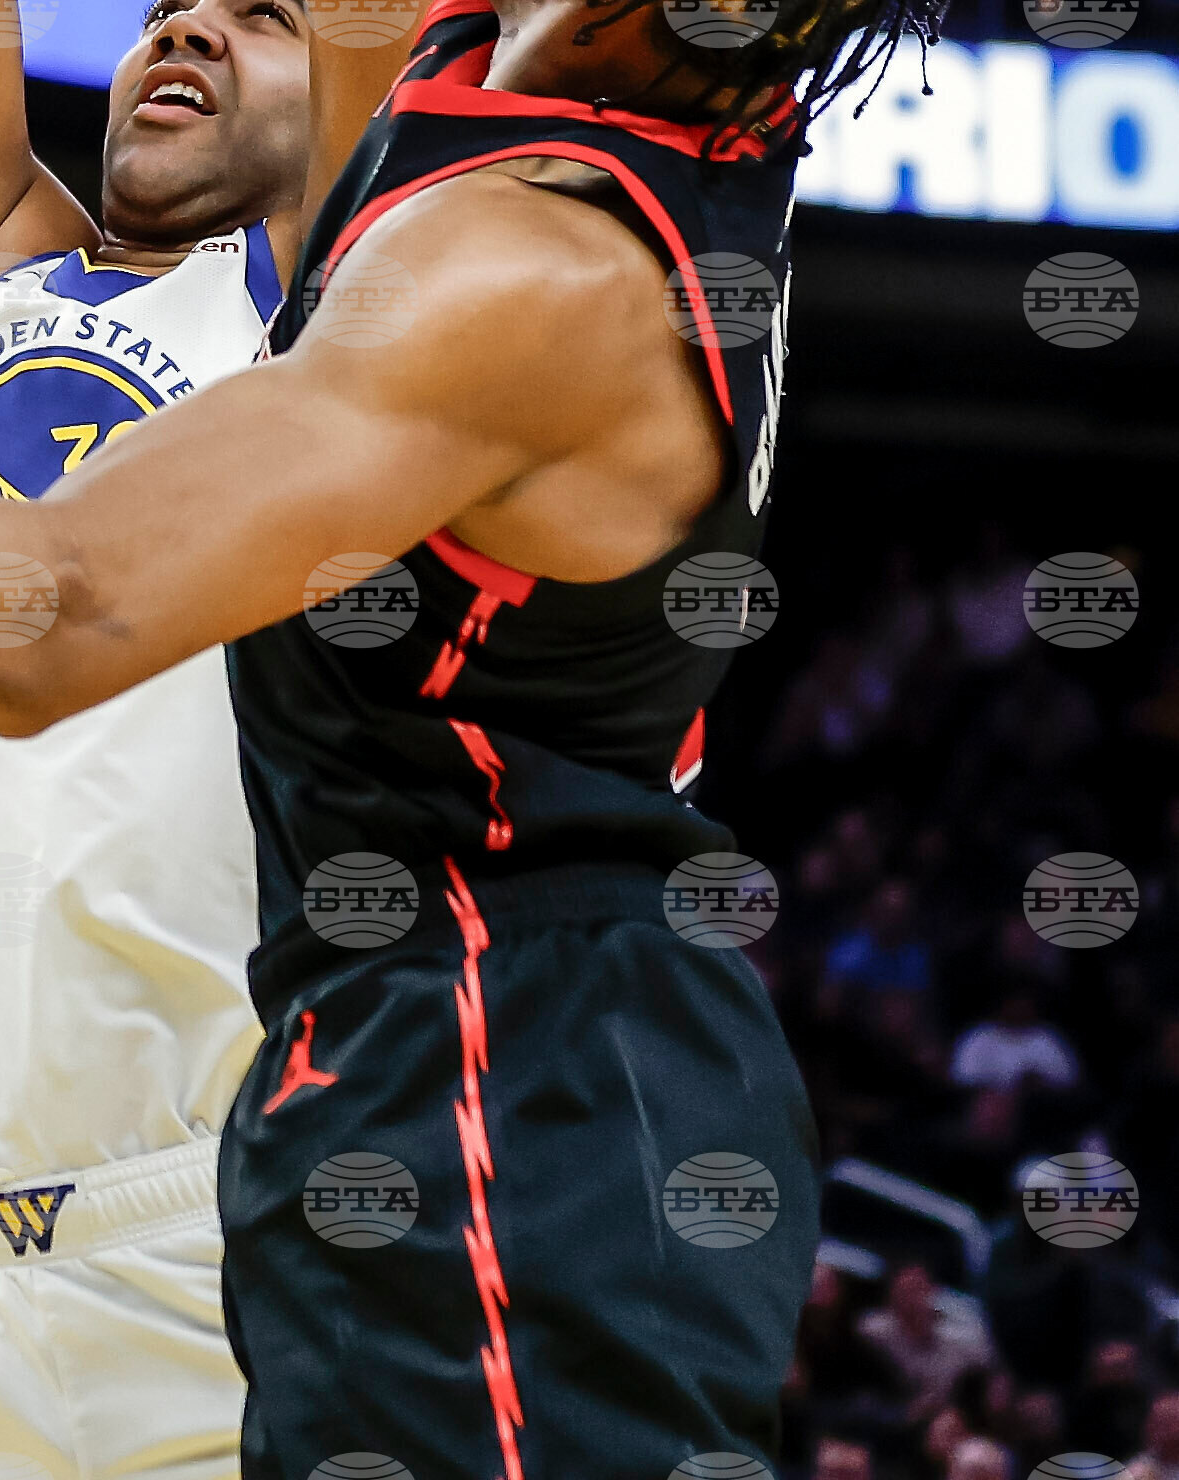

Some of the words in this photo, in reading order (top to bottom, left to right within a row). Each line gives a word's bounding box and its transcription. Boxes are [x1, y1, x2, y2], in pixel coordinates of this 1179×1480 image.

[794, 28, 1179, 232] RIO
[191, 242, 239, 253] en
[75, 312, 195, 401] STATE
